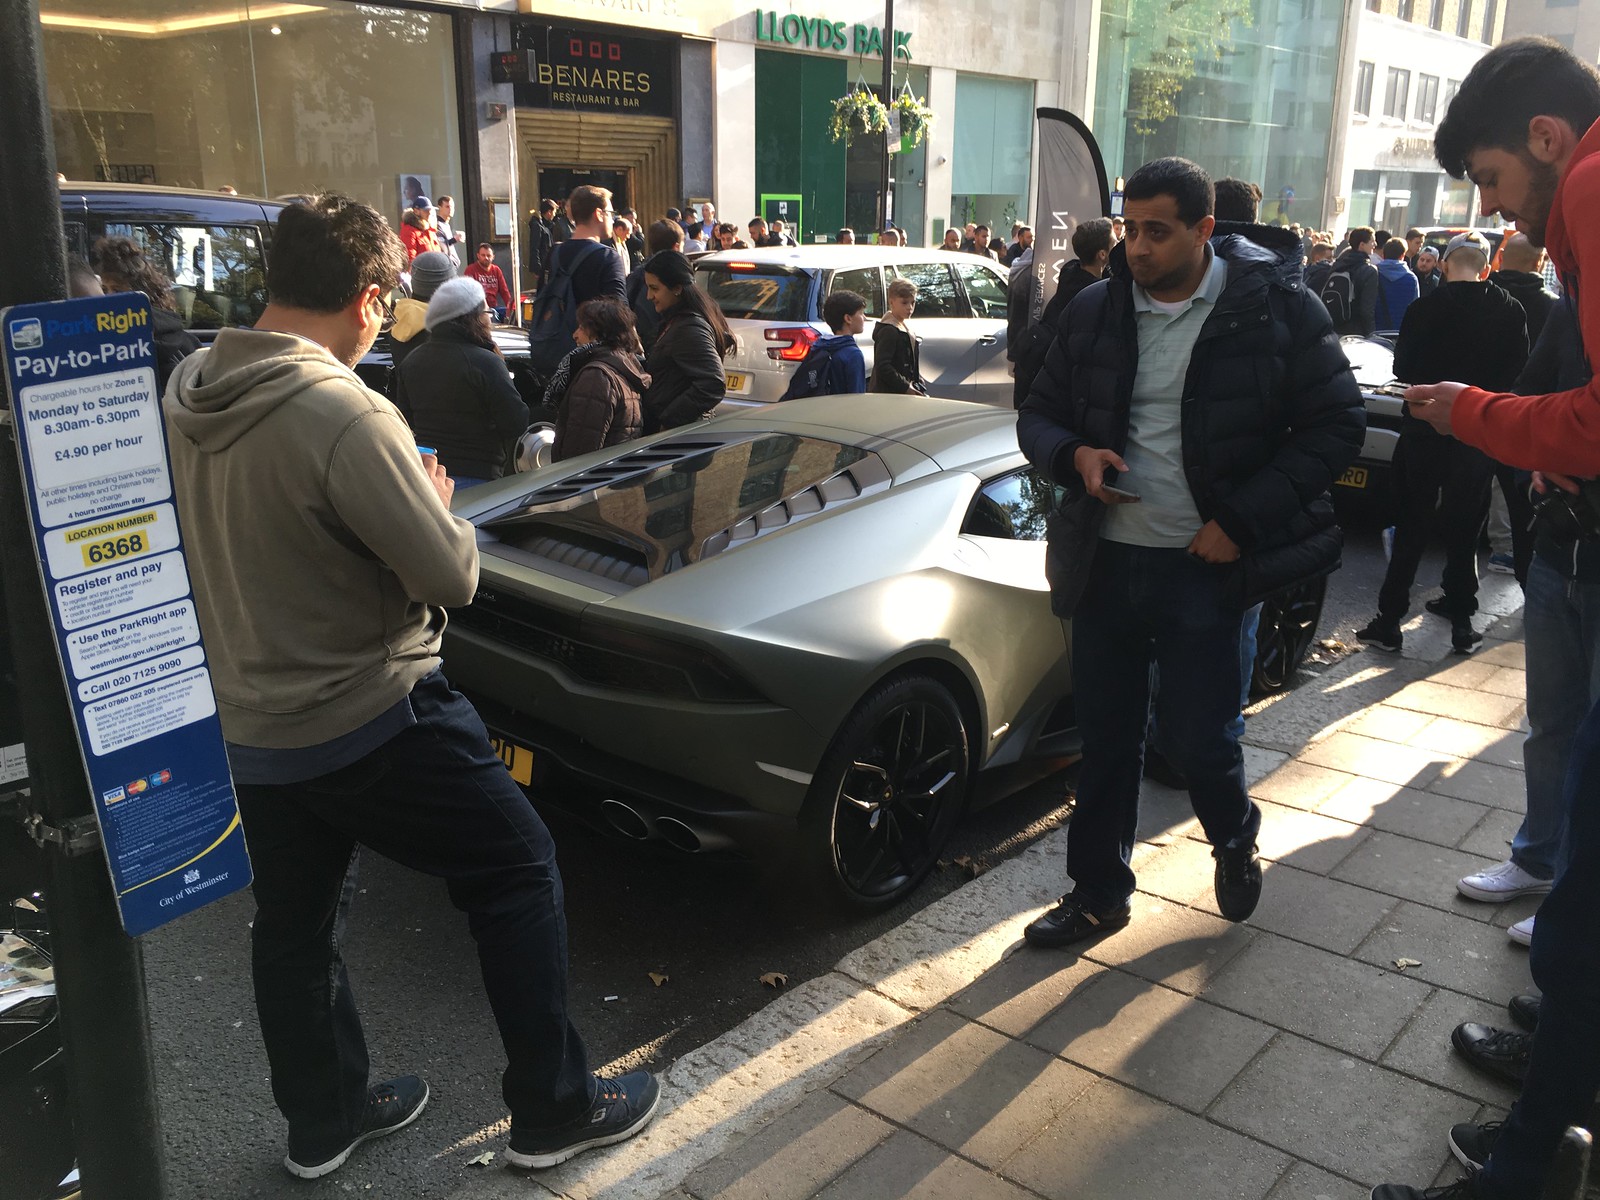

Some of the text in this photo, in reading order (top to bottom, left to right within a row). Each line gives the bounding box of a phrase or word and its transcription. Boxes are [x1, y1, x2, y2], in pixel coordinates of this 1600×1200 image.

[756, 8, 848, 50] LLOYDS
[538, 63, 651, 93] BENARES
[552, 91, 640, 107] RESTAURANT & BAR
[45, 308, 148, 338] ParkRight
[14, 338, 152, 378] Pay-to-Park
[30, 376, 144, 403] Chargeable hours for Zone E
[727, 375, 738, 388] TD
[28, 391, 150, 421] Monday to Saturday
[44, 408, 141, 436] 8.30am-6.30pm
[54, 436, 144, 461] £4.90 per hour
[46, 497, 66, 507] public
[68, 491, 95, 500] holidays
[110, 480, 141, 491] Christmas
[51, 488, 67, 496] other
[88, 477, 117, 487] including
[118, 472, 134, 480] bank
[100, 494, 122, 502] charge
[74, 509, 95, 517] hours
[97, 501, 130, 512] maximum
[68, 514, 154, 541] LOCATION NUMBER
[89, 534, 142, 563] 6368
[60, 562, 161, 596] Register and pay
[79, 608, 186, 644] Use the ParkRight app
[91, 658, 182, 694] Call 020 7125 9090
[93, 704, 107, 712] Text
[130, 692, 142, 700] 022
[144, 688, 156, 696] 205
[160, 872, 229, 907] City of Westminster
